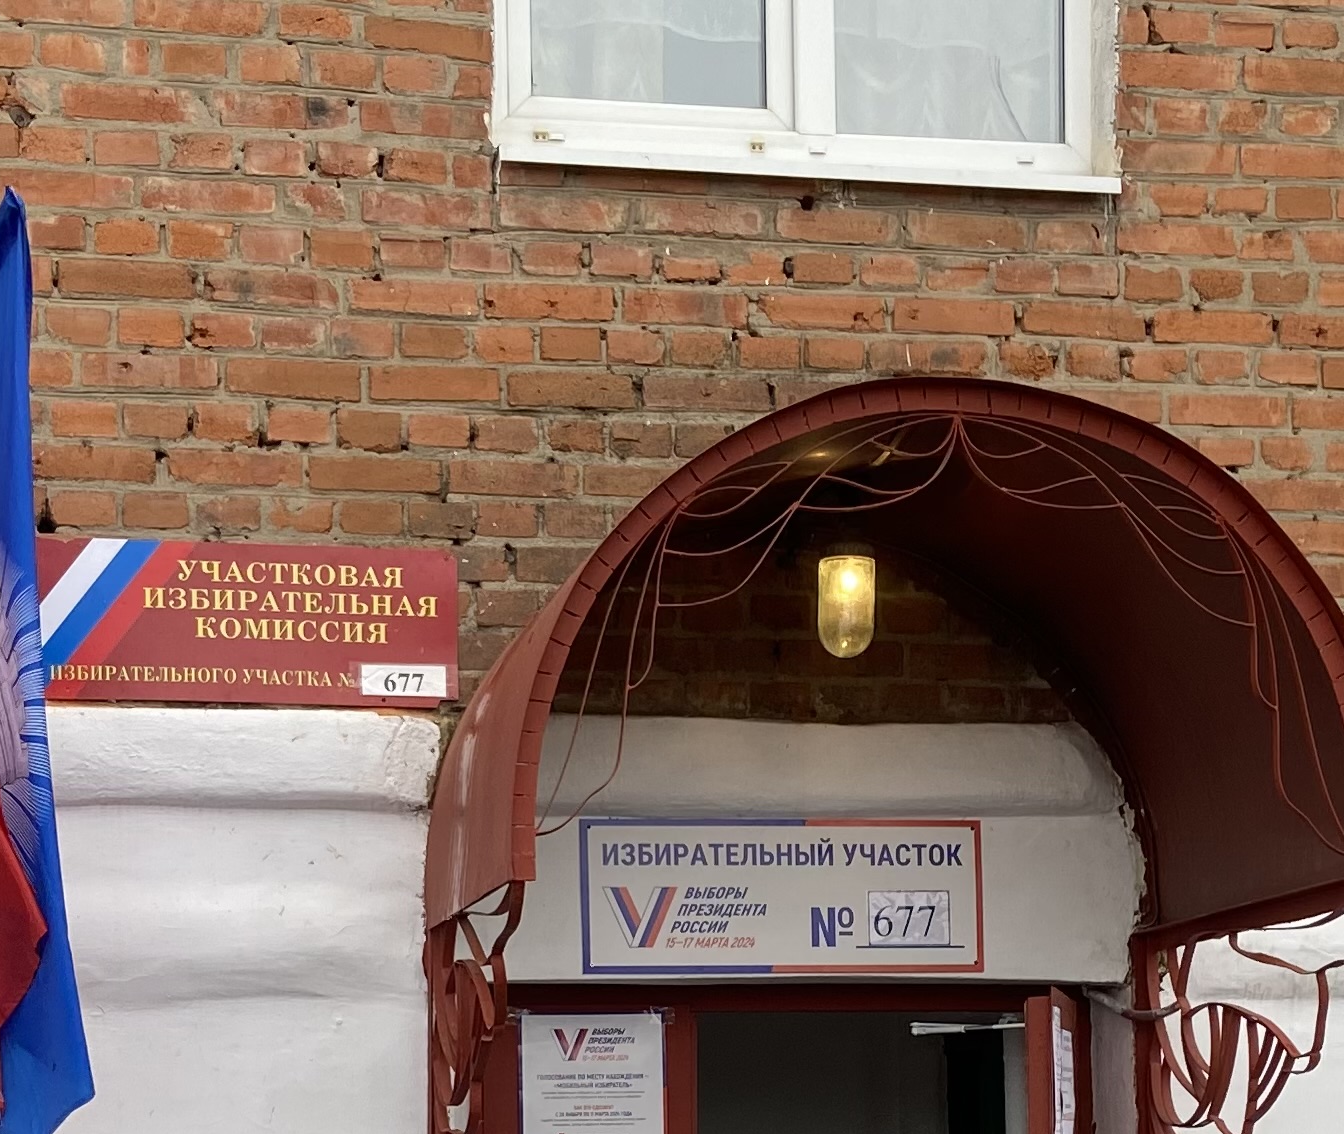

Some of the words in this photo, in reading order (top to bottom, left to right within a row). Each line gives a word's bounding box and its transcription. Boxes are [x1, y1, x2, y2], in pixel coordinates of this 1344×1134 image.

[177, 559, 404, 589] УЧАСТКОВАЯ
[142, 587, 438, 618] ИЗБИРАТЕЛЬНАЯ
[195, 617, 388, 645] КОМИССИЯ
[49, 664, 237, 686] ИЗБИРАТЕЛЬНОГО
[243, 668, 332, 688] УЧАСТКА
[383, 672, 425, 694] 677
[602, 838, 834, 867] ИЗБИРАТЕЛЬНЫЙ
[844, 843, 963, 867] УЧАСТОК
[684, 886, 748, 900] ВЫБОРЫ
[676, 903, 767, 919] ПРЕЗИДЕНТА
[670, 921, 729, 934] РОССИИ
[810, 906, 855, 948] №
[873, 905, 937, 938] 677
[695, 937, 730, 949] МАРТА
[731, 937, 756, 949] 2024
[591, 1028, 626, 1036] ВЫБОРЫ
